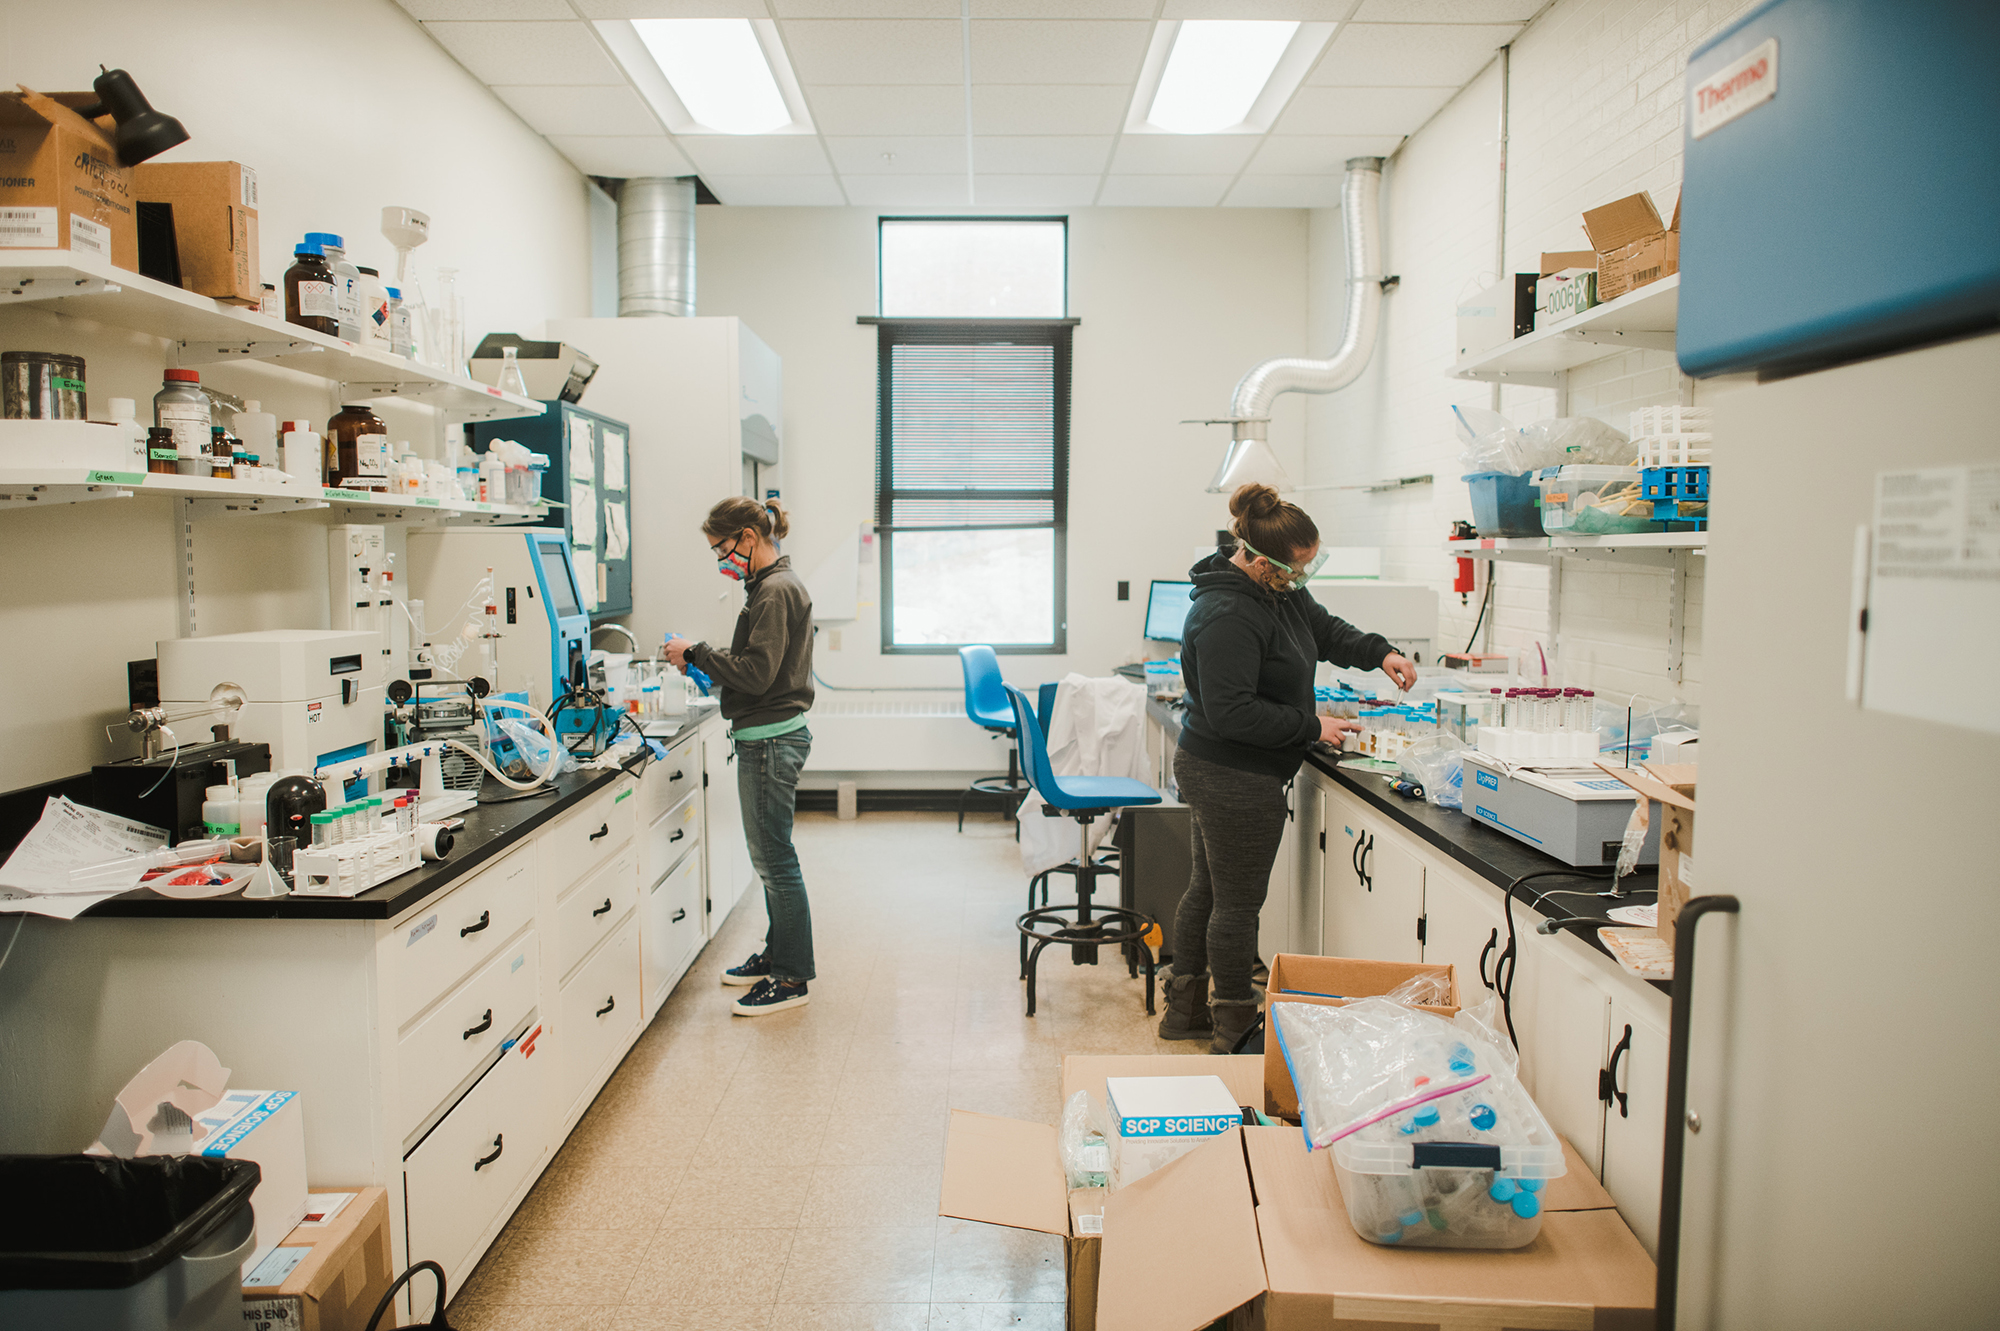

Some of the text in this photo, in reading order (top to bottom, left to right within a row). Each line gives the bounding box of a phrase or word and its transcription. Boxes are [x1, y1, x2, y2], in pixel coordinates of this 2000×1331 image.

[1697, 57, 1768, 114] Thermo
[96, 195, 131, 215] CNDITIONER
[309, 712, 321, 723] HOT
[1478, 772, 1497, 787] DigiPREP
[210, 1091, 292, 1151] SCP SCIENCE
[1126, 1117, 1238, 1134] SCP SCIENCE
[243, 1308, 288, 1320] HIS END
[255, 1321, 271, 1331] UP
